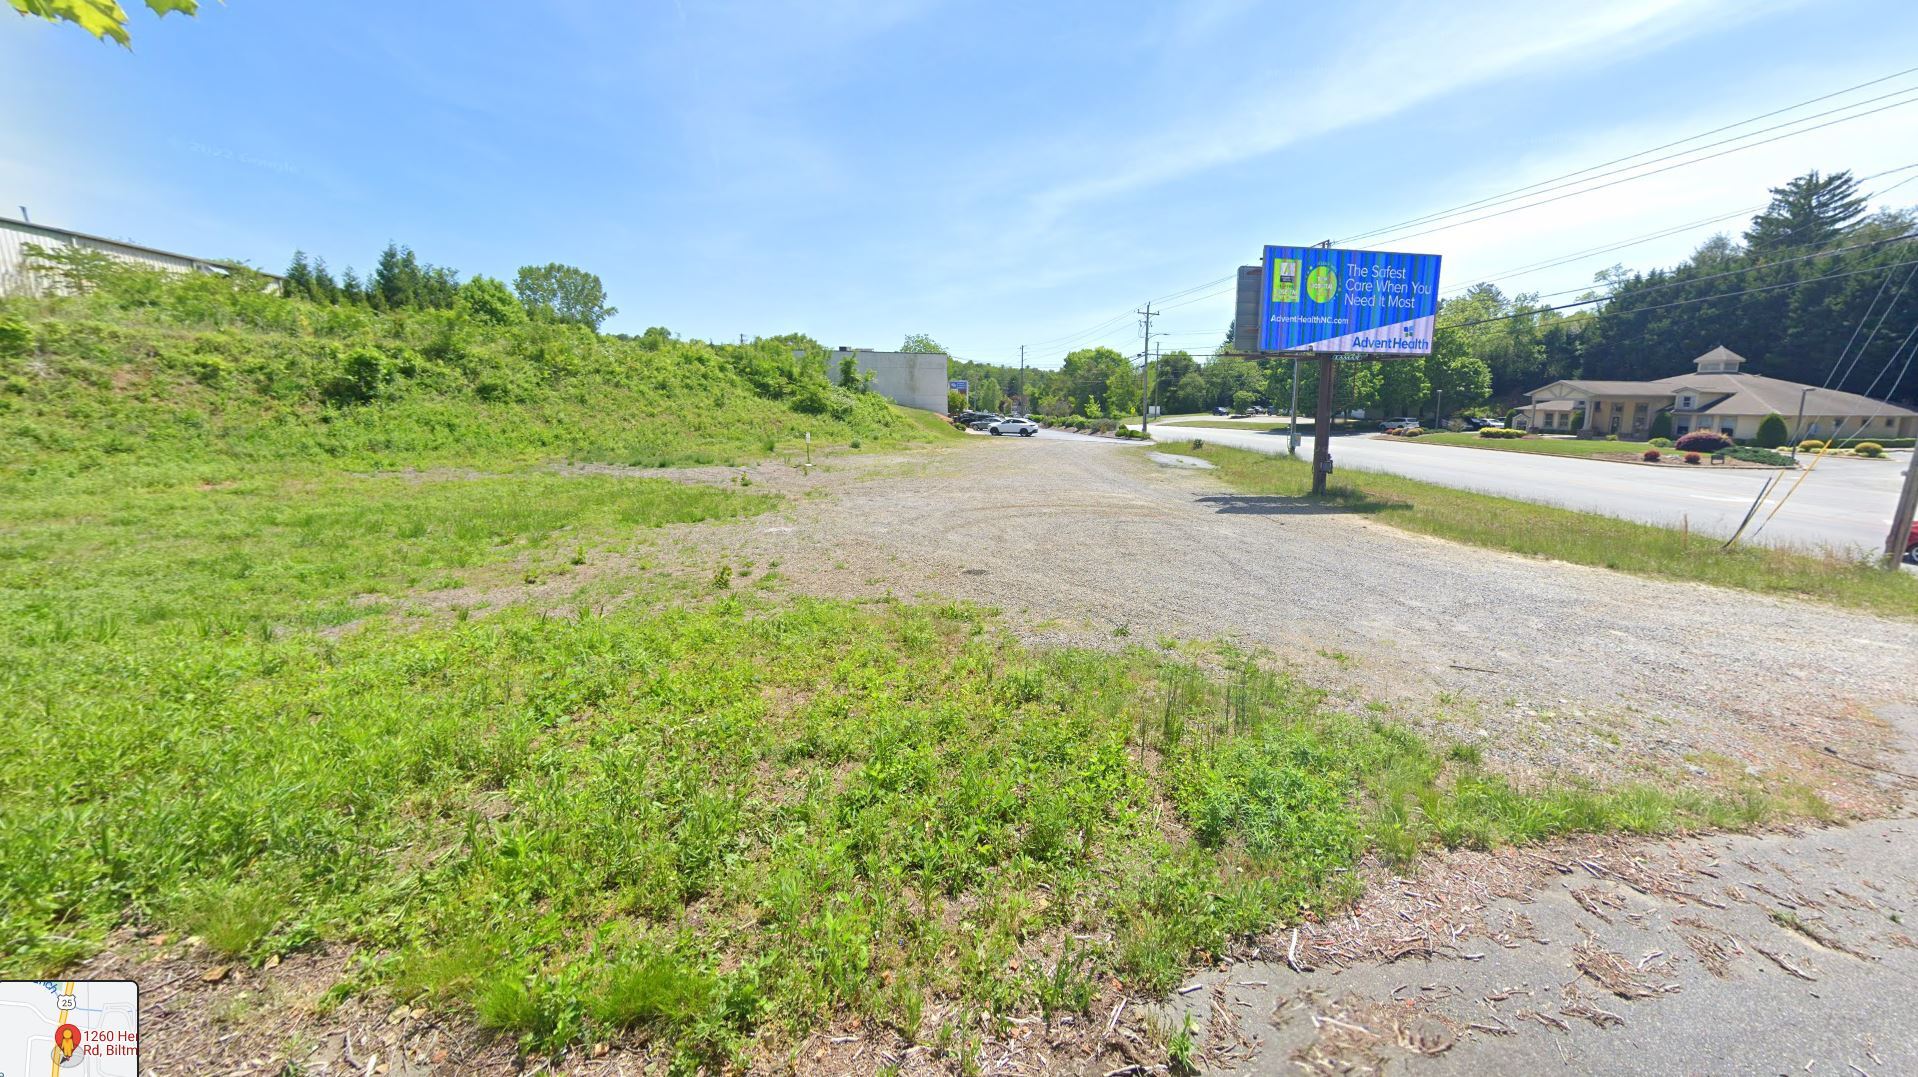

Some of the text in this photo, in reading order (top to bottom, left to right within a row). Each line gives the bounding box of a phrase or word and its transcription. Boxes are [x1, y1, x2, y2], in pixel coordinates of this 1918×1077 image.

[1347, 263, 1406, 280] The Safest
[1345, 279, 1432, 295] Care When You
[1344, 294, 1416, 309] Need It Most
[1270, 314, 1350, 325] AdventHealthNC.com
[1352, 335, 1430, 350] AdventHealth
